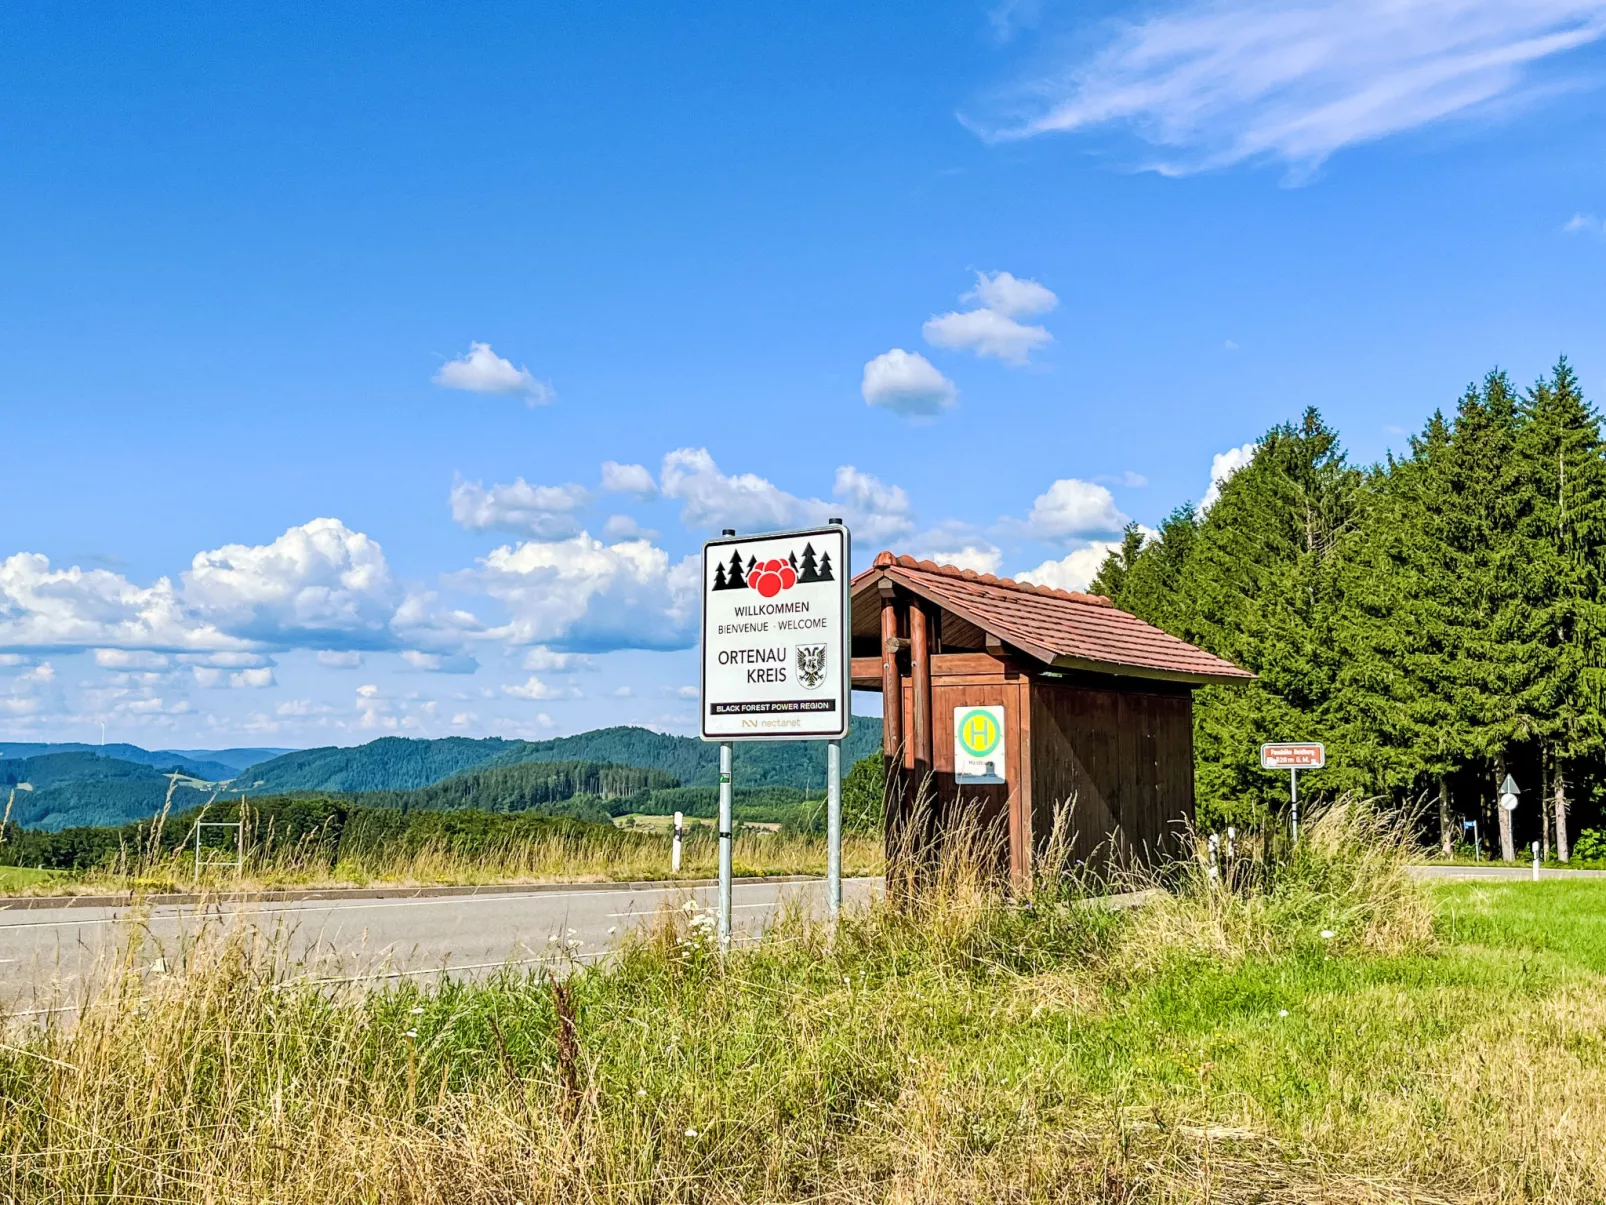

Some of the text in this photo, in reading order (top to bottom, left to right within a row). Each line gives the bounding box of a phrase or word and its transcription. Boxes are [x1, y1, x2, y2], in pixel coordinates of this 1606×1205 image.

[734, 602, 810, 617] WILLKOMMEN
[718, 618, 827, 634] BIENVENUE WELCOME
[718, 647, 787, 665] ORTENAU
[747, 667, 787, 684] KREIS
[716, 701, 829, 713] BLACK FOREST POWER REGION
[761, 718, 801, 728] nectanet
[971, 719, 988, 746] H
